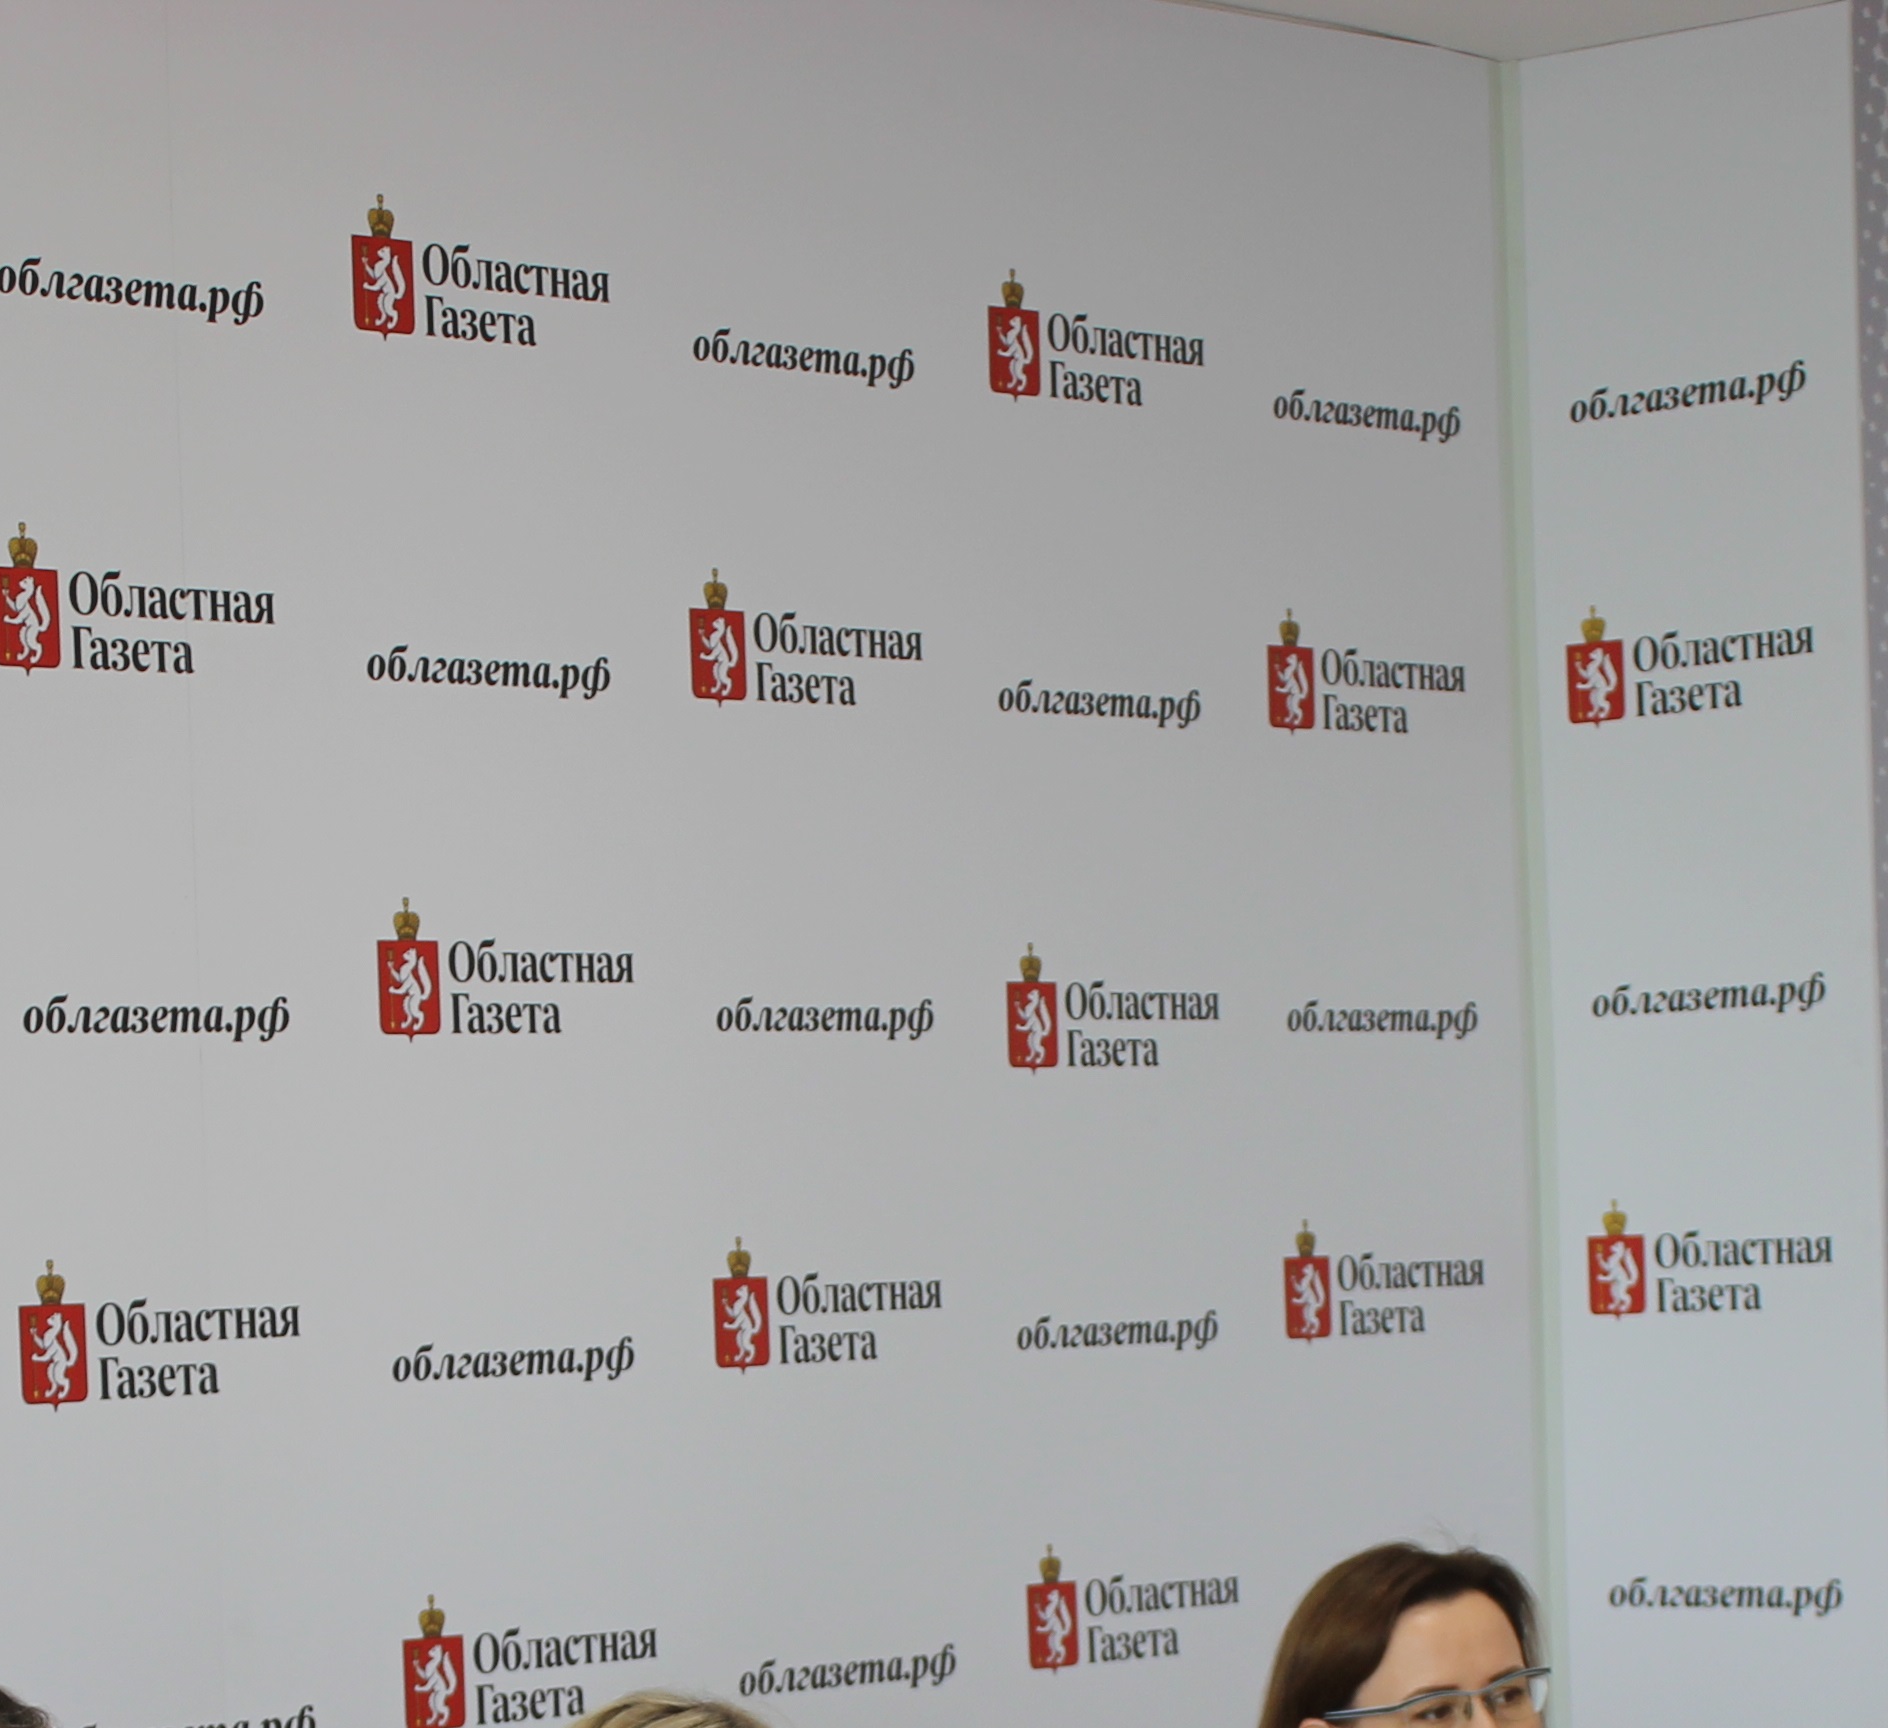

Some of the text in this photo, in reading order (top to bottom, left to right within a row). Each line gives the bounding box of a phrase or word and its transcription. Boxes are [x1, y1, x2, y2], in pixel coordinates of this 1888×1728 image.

[422, 243, 609, 304] Областная
[425, 295, 537, 347] Газета
[1047, 313, 1204, 367] Областная
[693, 328, 915, 390] облгазета.рф
[1049, 359, 1143, 407] Газета
[1570, 359, 1806, 423] облгазета.рф
[1273, 389, 1461, 444] облгазета.рф
[68, 571, 275, 625] Областная
[71, 625, 195, 674] Газета
[753, 612, 923, 661] Областная
[1633, 626, 1813, 672] Областная
[367, 645, 611, 700] облгазета.рф
[756, 660, 857, 706] Газета
[1321, 648, 1465, 693] Областная
[998, 679, 1201, 729] облгазета.рф
[1323, 694, 1409, 734] Газета
[1636, 676, 1743, 717] Газета
[448, 939, 634, 984] Областная
[451, 993, 562, 1034] Газета
[1065, 980, 1219, 1021] Областная
[1592, 971, 1826, 1017] облгазета.рф
[23, 995, 290, 1043] облгазета.рф
[716, 996, 934, 1041] облгазета.рф
[1287, 1000, 1478, 1040] облгазета.рф
[1067, 1029, 1159, 1067] Газета
[1654, 1230, 1832, 1268] Областная
[776, 1272, 942, 1316] Областная
[1337, 1252, 1484, 1292] Областная
[1339, 1300, 1425, 1336] Газета
[1657, 1278, 1761, 1313] Газета
[96, 1298, 300, 1346] Областная
[780, 1325, 878, 1364] Газета
[1017, 1310, 1218, 1351] облгазета.рф
[99, 1357, 220, 1400] Газета
[392, 1336, 635, 1382] облгазета.рф
[1084, 1575, 1239, 1617] Областная
[1609, 1577, 1843, 1617] облгазета.рф
[473, 1628, 657, 1674] Областная
[1088, 1626, 1179, 1664] Газета
[739, 1644, 956, 1697] облгазета.рф
[477, 1684, 584, 1725] Газета
